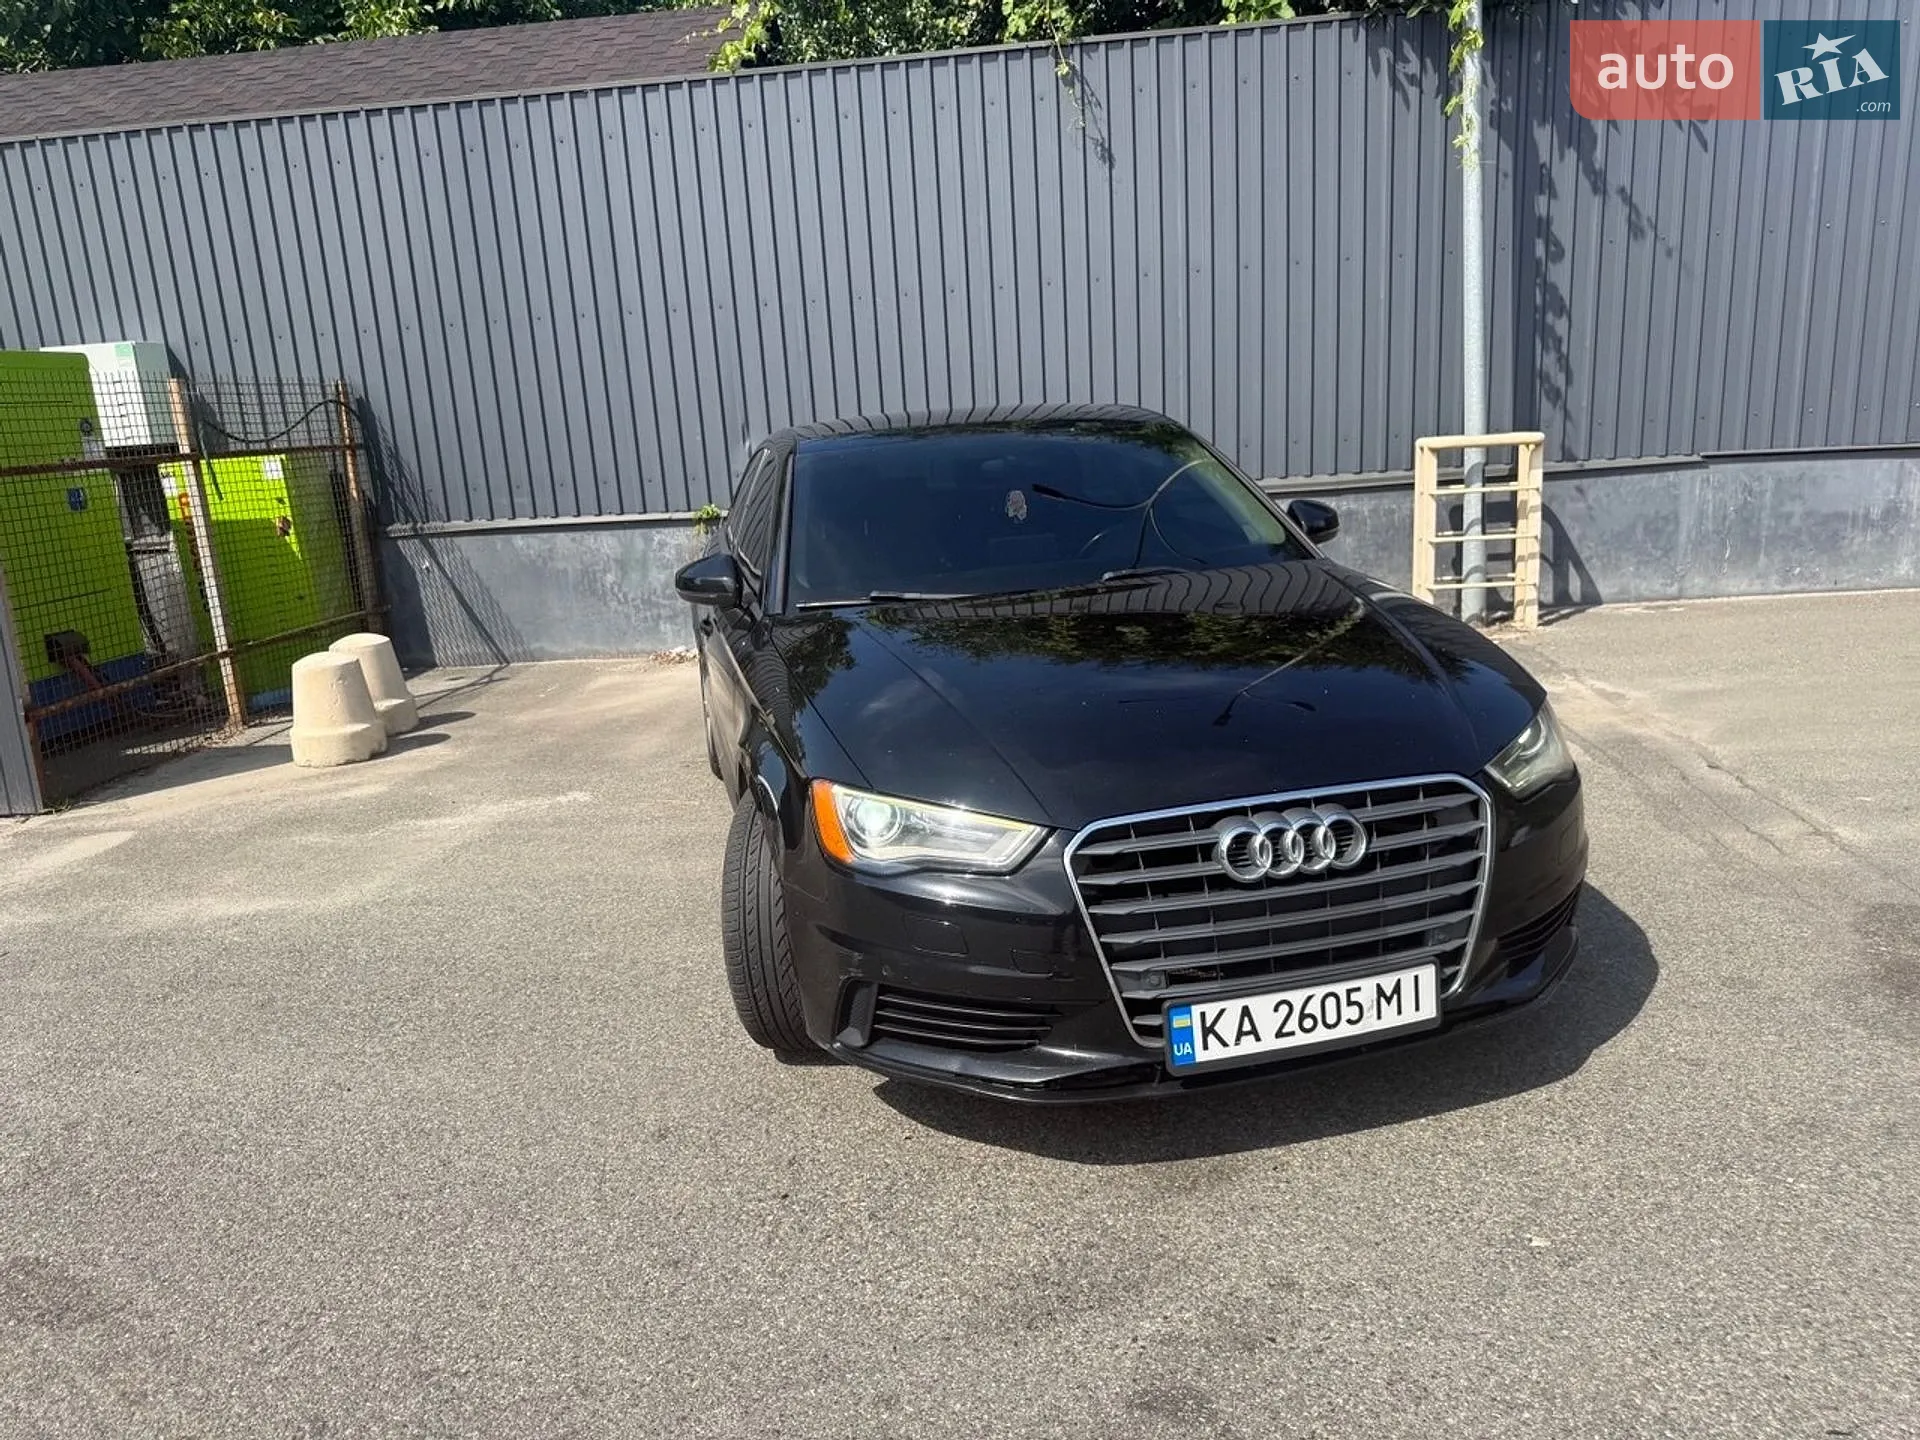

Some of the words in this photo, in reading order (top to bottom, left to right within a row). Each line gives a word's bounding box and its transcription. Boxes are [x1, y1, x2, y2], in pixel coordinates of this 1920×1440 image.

[1200, 1005, 1262, 1051] KA
[1273, 987, 1364, 1039] 2605
[1375, 974, 1420, 1021] MI
[1173, 1043, 1193, 1057] UA
